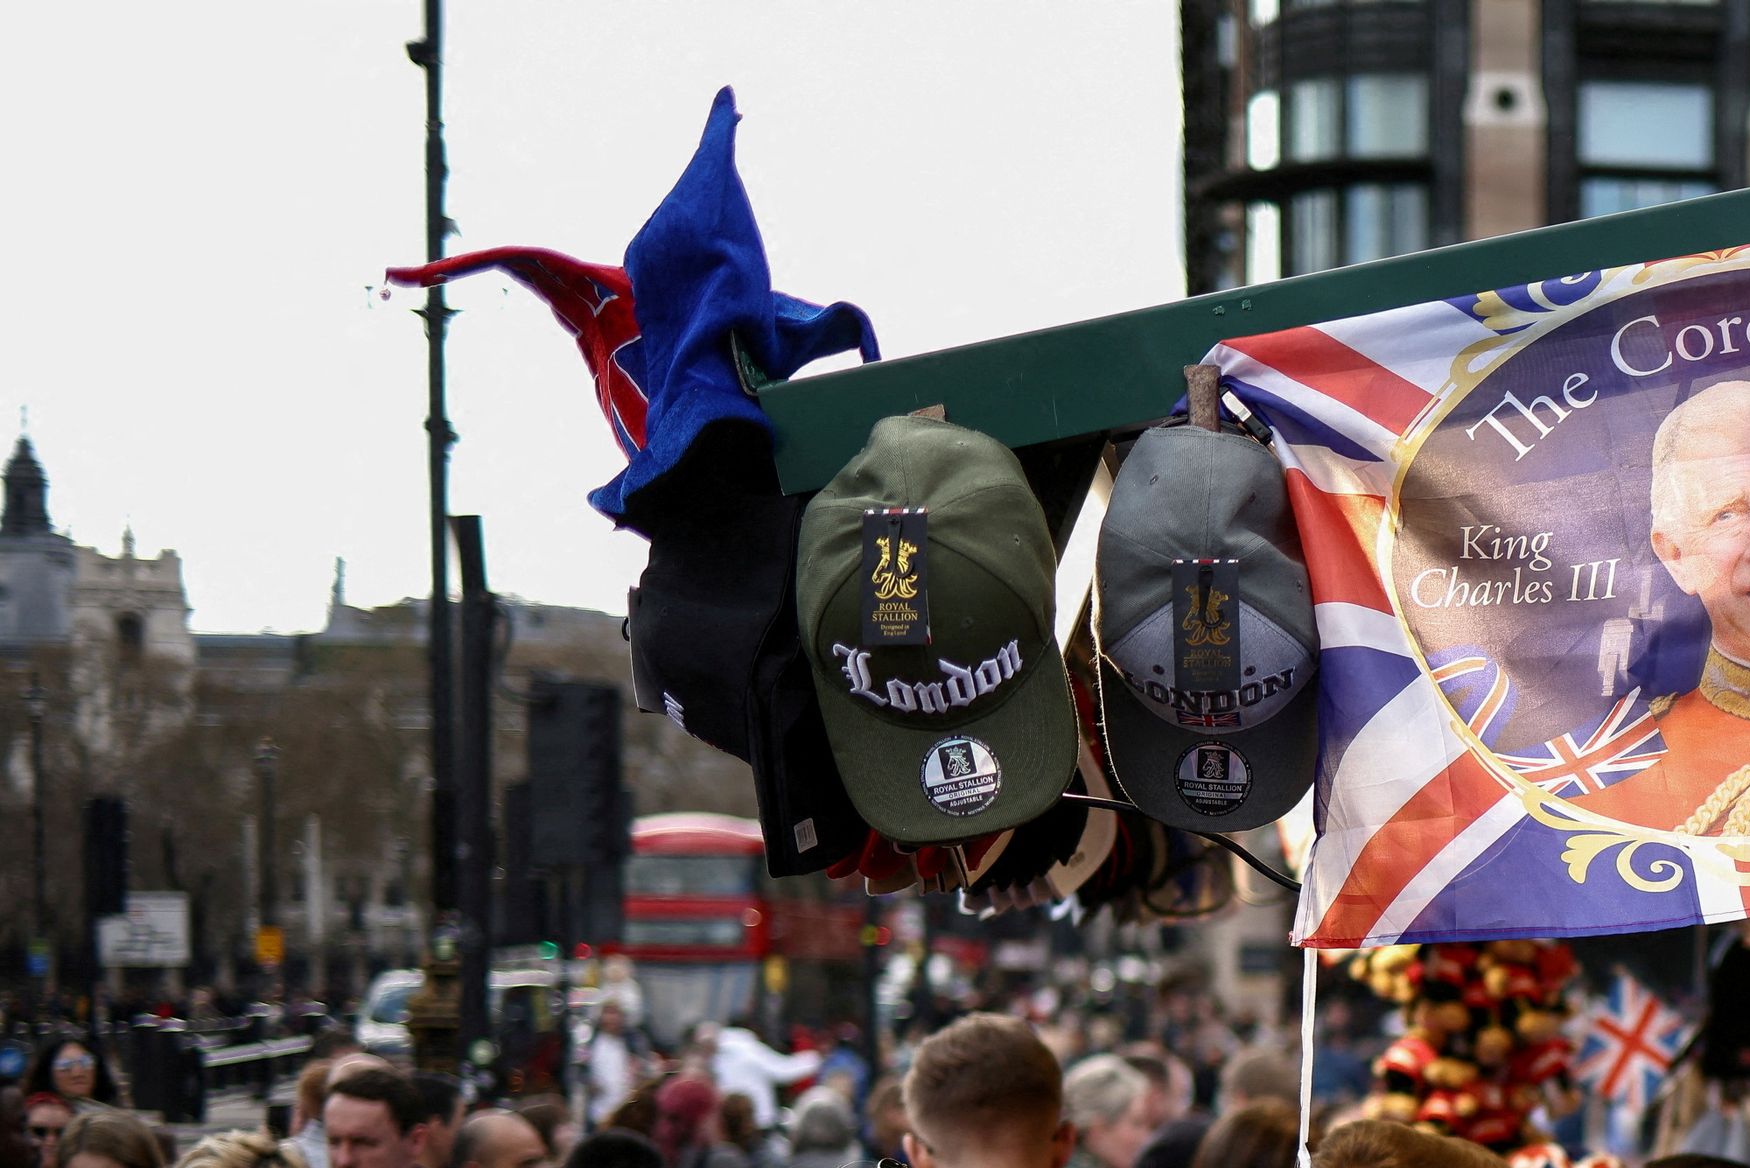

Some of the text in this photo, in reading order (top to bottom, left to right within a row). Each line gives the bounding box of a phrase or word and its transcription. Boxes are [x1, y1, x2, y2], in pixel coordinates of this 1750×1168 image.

[1466, 368, 1598, 461] The
[1459, 524, 1554, 572] King
[1410, 557, 1618, 612] Charles III
[879, 602, 911, 611] ROYAL
[872, 612, 918, 622] STALLION
[832, 639, 1023, 714] London
[1122, 664, 1297, 713] LONDON
[933, 776, 994, 795] ROYAL STALLION
[948, 788, 981, 799] ORIGINAL
[1184, 781, 1242, 792] ROYAL STALLION
[949, 795, 983, 807] ADJUSTABLE
